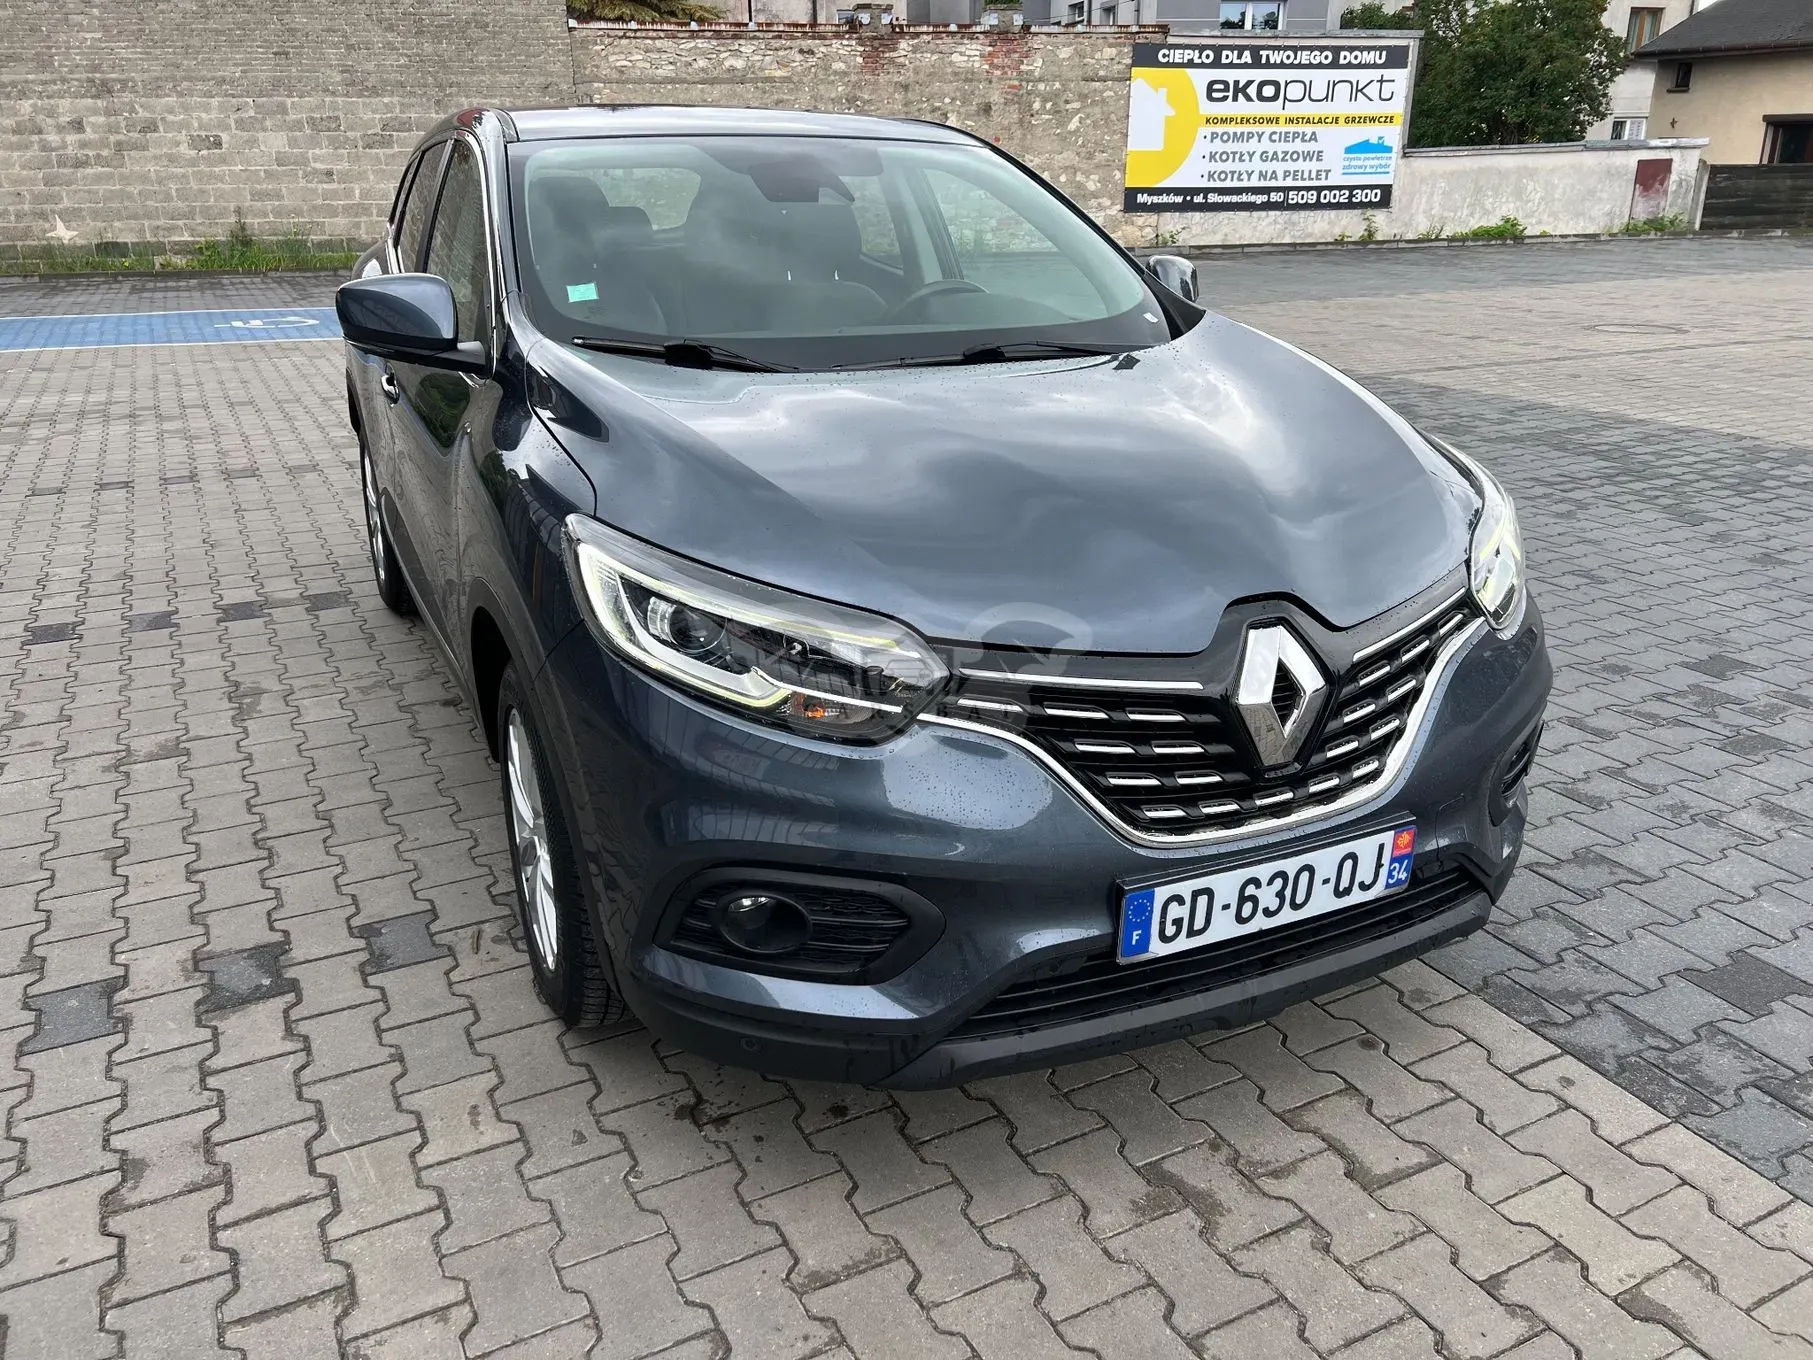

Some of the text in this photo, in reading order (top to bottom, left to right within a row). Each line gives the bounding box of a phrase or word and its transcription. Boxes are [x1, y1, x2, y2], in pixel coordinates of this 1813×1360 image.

[1157, 49, 1387, 64] CIEPŁO DLA TWOJEGO DOMU
[1205, 115, 1395, 125] KOMPLEKSOWE INSTALACJE GRZEWCZE
[1209, 131, 1319, 144] POMPY CIEPŁA
[1208, 150, 1324, 163] KOTŁY GAZOWE
[1206, 169, 1332, 182] KOTŁY NA PELLET
[1136, 193, 1184, 205] Myszków
[1207, 192, 1269, 204] Słowackiego
[1269, 192, 1285, 202] 50
[1288, 190, 1318, 204] 509
[1320, 190, 1350, 203] 002
[1351, 189, 1382, 203] 300
[1387, 859, 1409, 886] 34
[1157, 842, 1386, 945] GD-630-QJ
[1131, 929, 1142, 947] F
